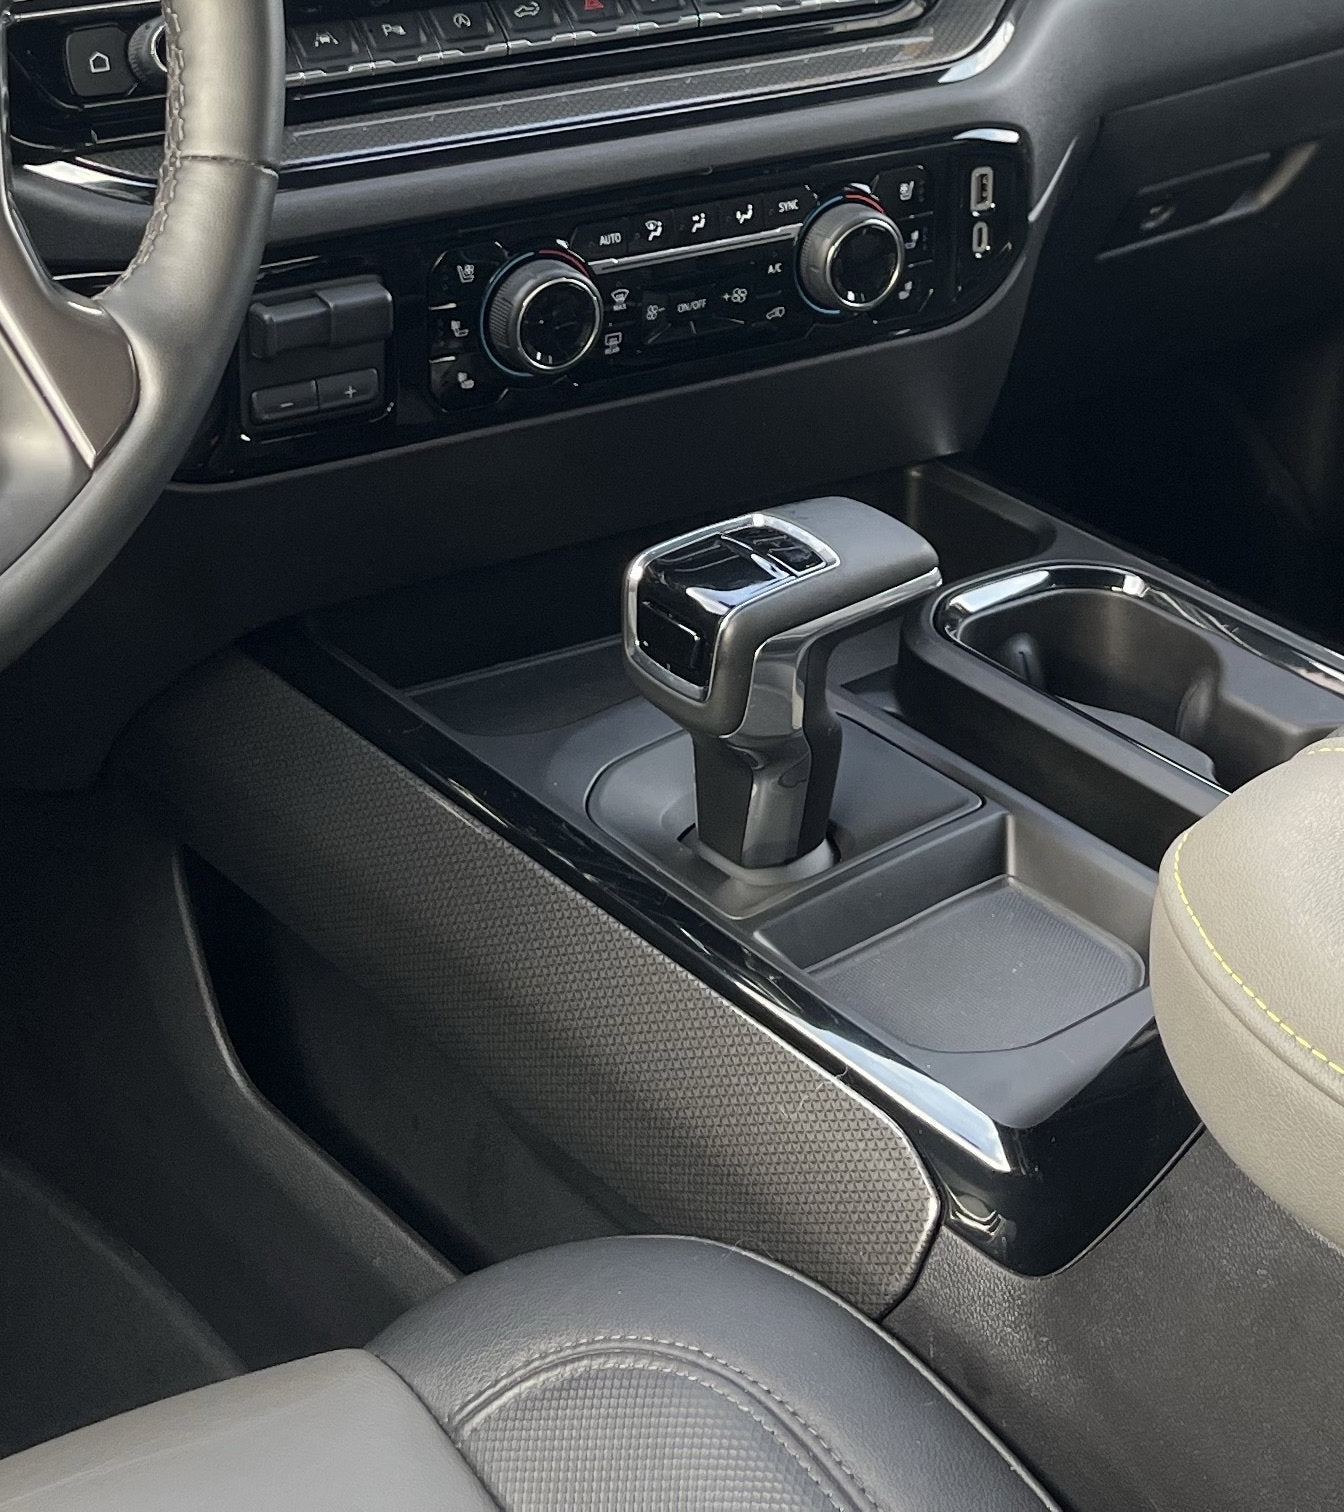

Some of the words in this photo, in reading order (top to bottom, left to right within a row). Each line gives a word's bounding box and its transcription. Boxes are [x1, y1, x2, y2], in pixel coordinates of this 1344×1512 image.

[778, 199, 800, 213] SYNC
[599, 232, 622, 246] AUTO
[767, 262, 783, 275] A/C
[676, 298, 707, 313] ON/OFF
